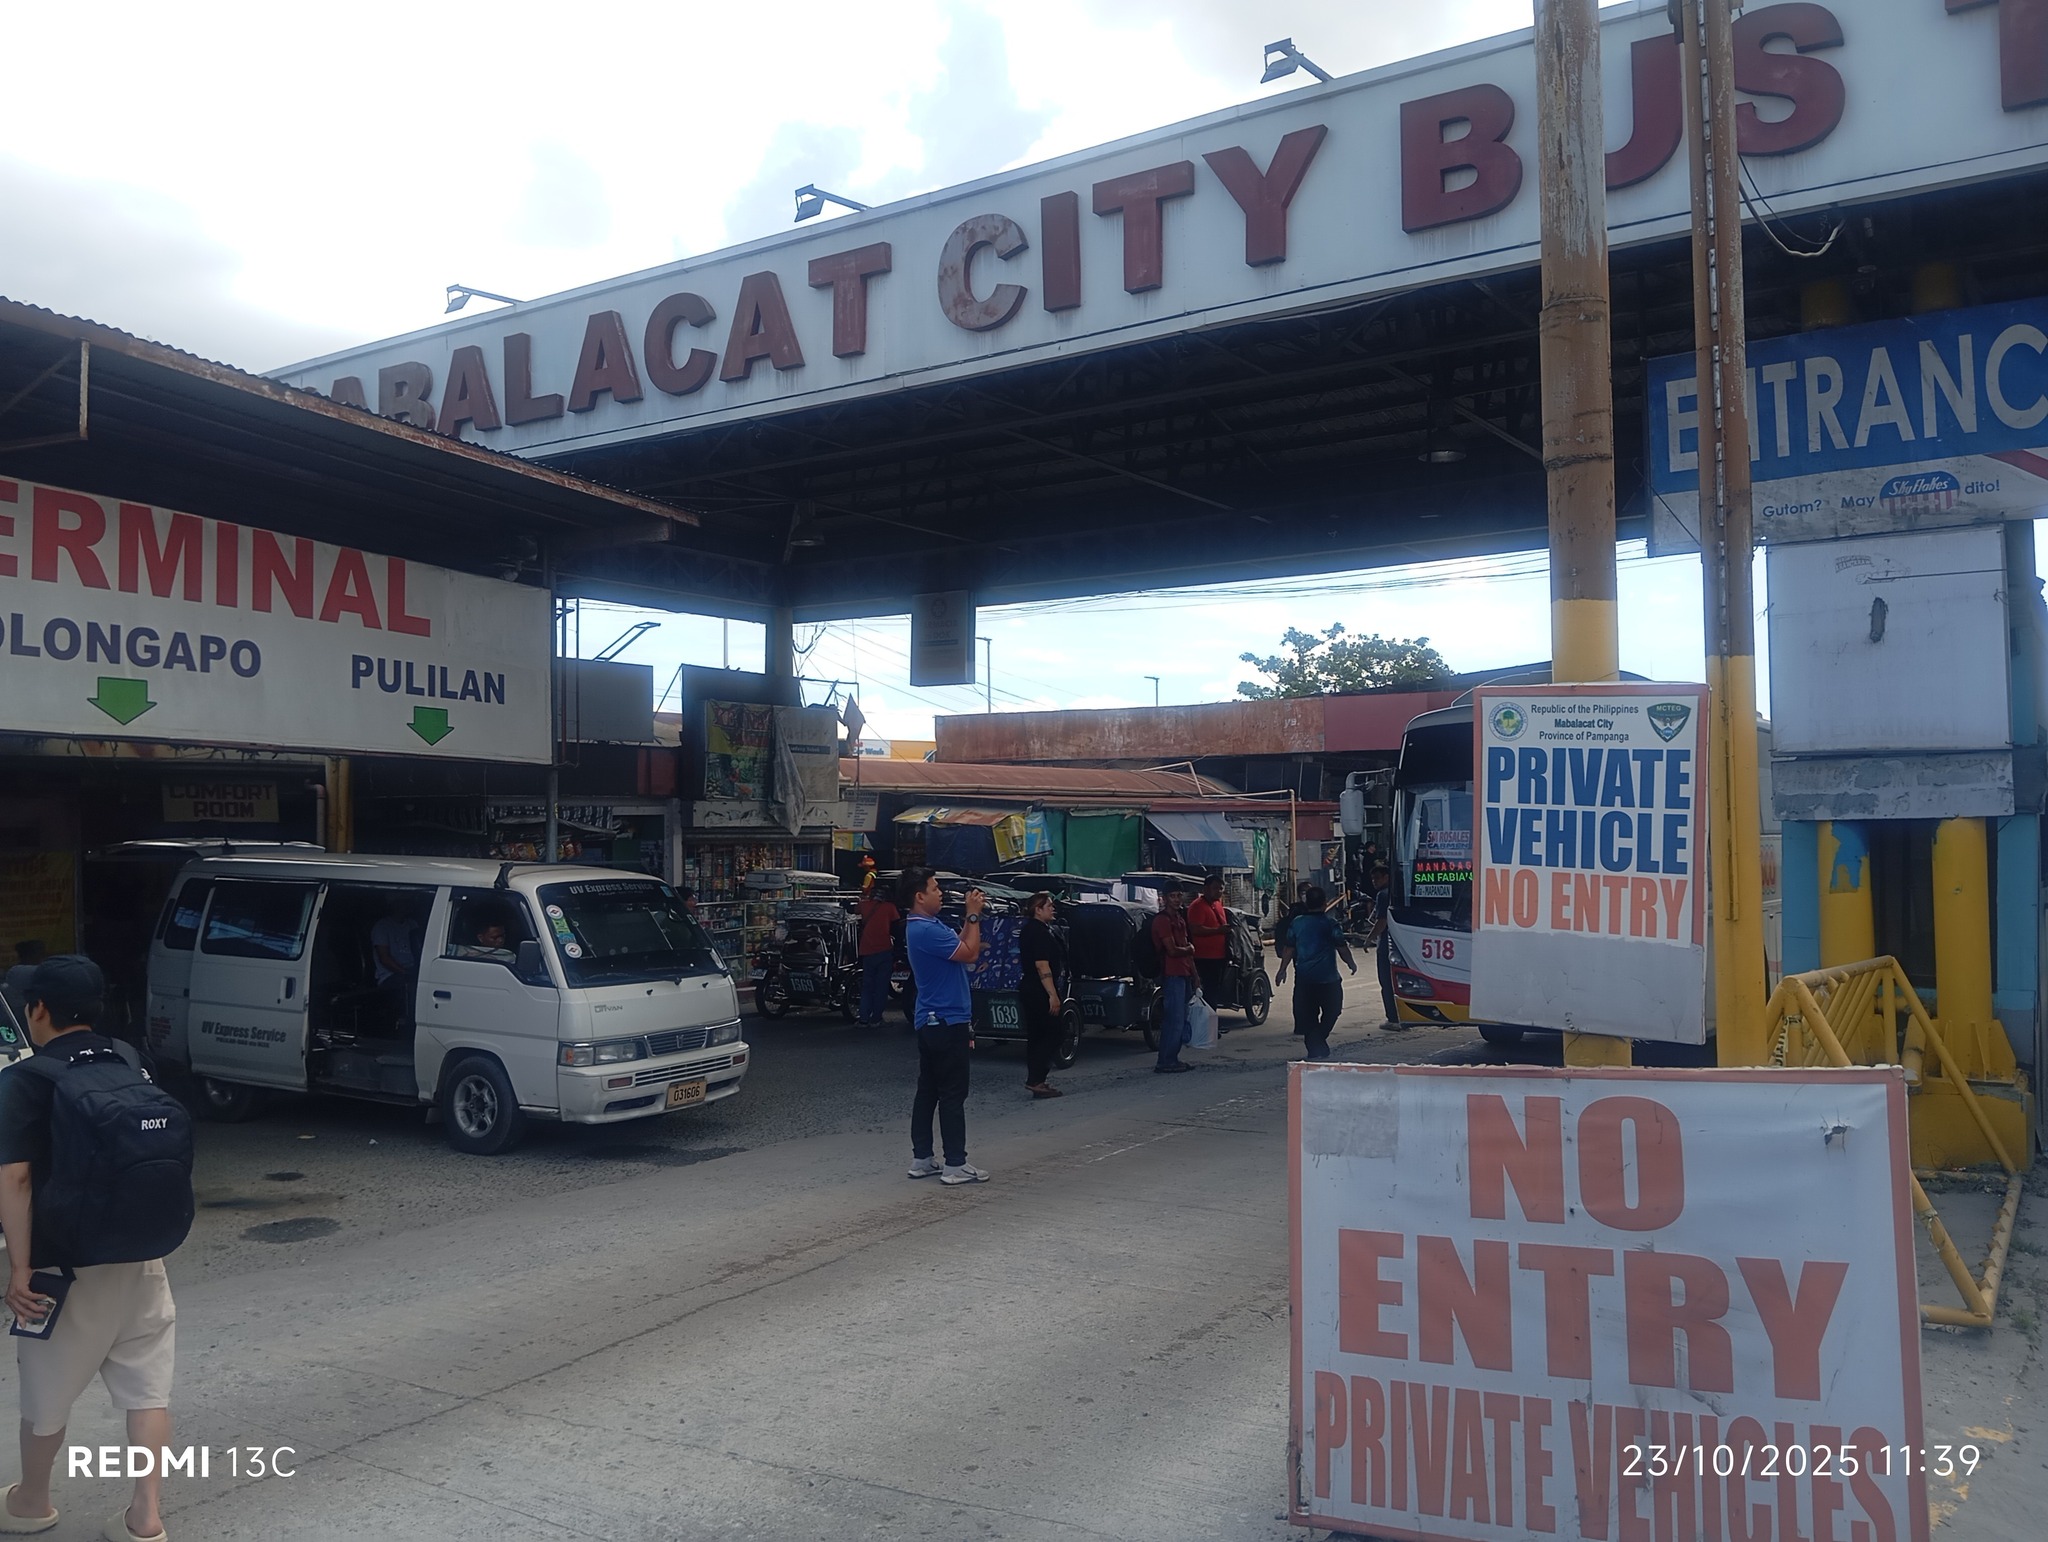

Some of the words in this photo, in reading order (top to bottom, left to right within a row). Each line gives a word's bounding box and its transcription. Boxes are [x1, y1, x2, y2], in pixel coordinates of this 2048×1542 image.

[301, 242, 891, 437] BALACAT
[938, 124, 1328, 332] CITY
[1665, 324, 2048, 473] ETRANC
[1762, 499, 1823, 518] Gutom?
[1841, 495, 1876, 509] May
[1965, 479, 2000, 495] dito!
[0, 613, 262, 678] LONGAPO
[352, 654, 505, 704] PULILAN
[1531, 704, 1565, 715] Republic
[1568, 704, 1577, 713] of
[1578, 704, 1591, 713] the
[1593, 704, 1639, 715] Philippines
[1554, 719, 1595, 728] Mabalacat
[1597, 719, 1614, 730] City
[1539, 731, 1574, 740] Province
[1576, 731, 1584, 740] of
[1586, 732, 1630, 743] Pampanga
[1487, 747, 1691, 809] PRIVATE
[169, 783, 276, 800] COMFORT
[193, 800, 255, 818] ROOM
[1486, 807, 1688, 875] VEHICLE
[569, 886, 584, 895] UV
[585, 883, 622, 893] Express
[622, 882, 655, 891] Service
[1414, 873, 1435, 883] SAN
[1484, 867, 1539, 929] NO
[1551, 871, 1688, 940] ENTRY
[1421, 938, 1455, 960] 518
[990, 1005, 1019, 1025] 1639
[201, 1021, 215, 1034] UV
[214, 1022, 250, 1038] Express
[250, 1026, 287, 1042] Service
[673, 1085, 701, 1101] 031606
[141, 1118, 168, 1130] ROXY
[1466, 1093, 1686, 1232] NO
[1338, 1228, 1850, 1402] ENTRY
[1314, 1370, 1556, 1533] PRIVATE
[1567, 1400, 1897, 1542] VEHICLES
